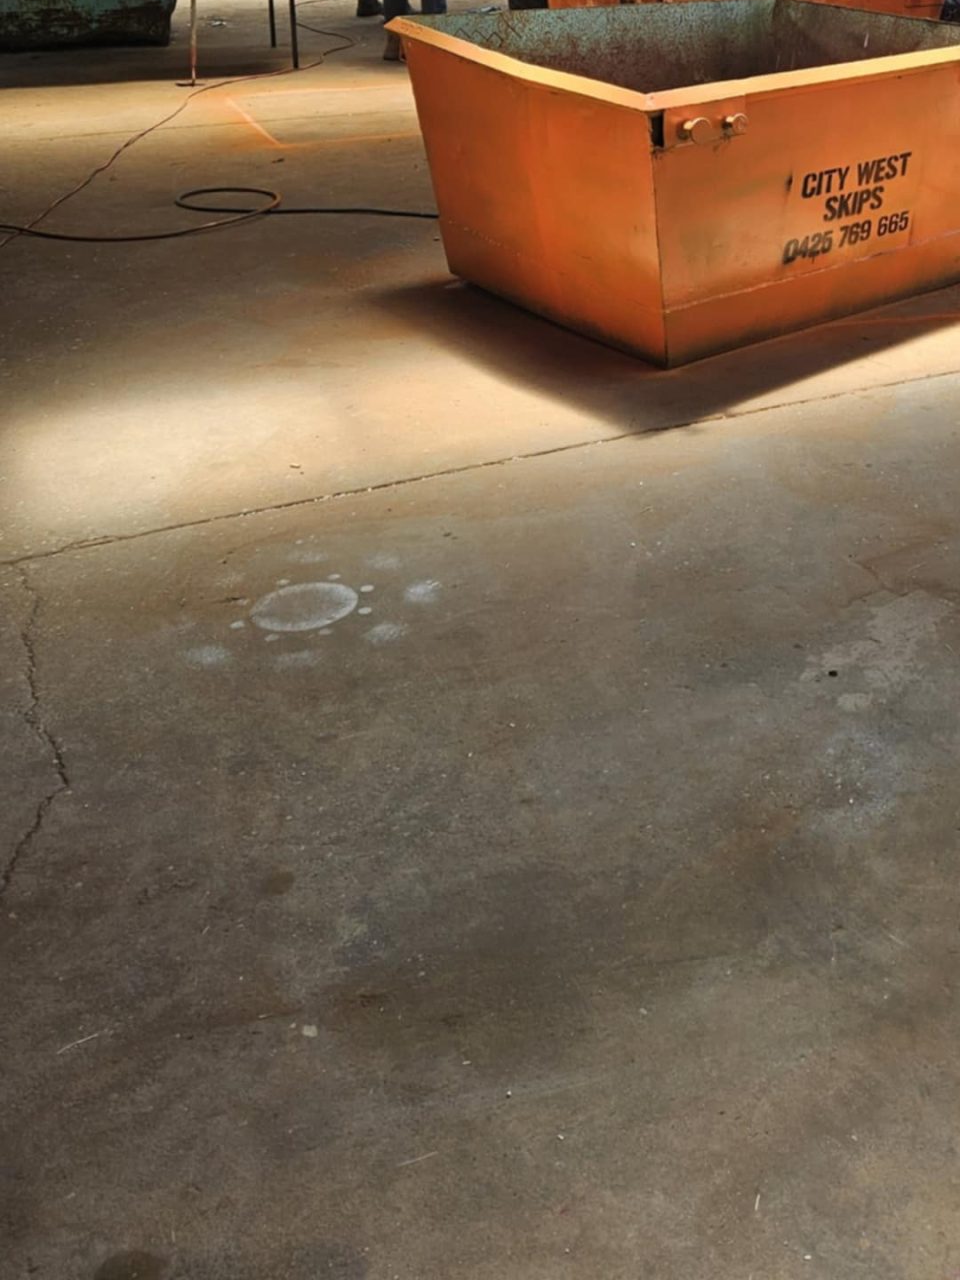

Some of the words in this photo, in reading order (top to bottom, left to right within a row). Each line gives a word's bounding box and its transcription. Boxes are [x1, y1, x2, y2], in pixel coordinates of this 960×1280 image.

[801, 166, 850, 199] CITY
[857, 151, 912, 187] WEST
[823, 185, 885, 222] SKIPS
[783, 230, 833, 265] 0425
[838, 219, 872, 248] 769
[876, 210, 909, 238] 665
